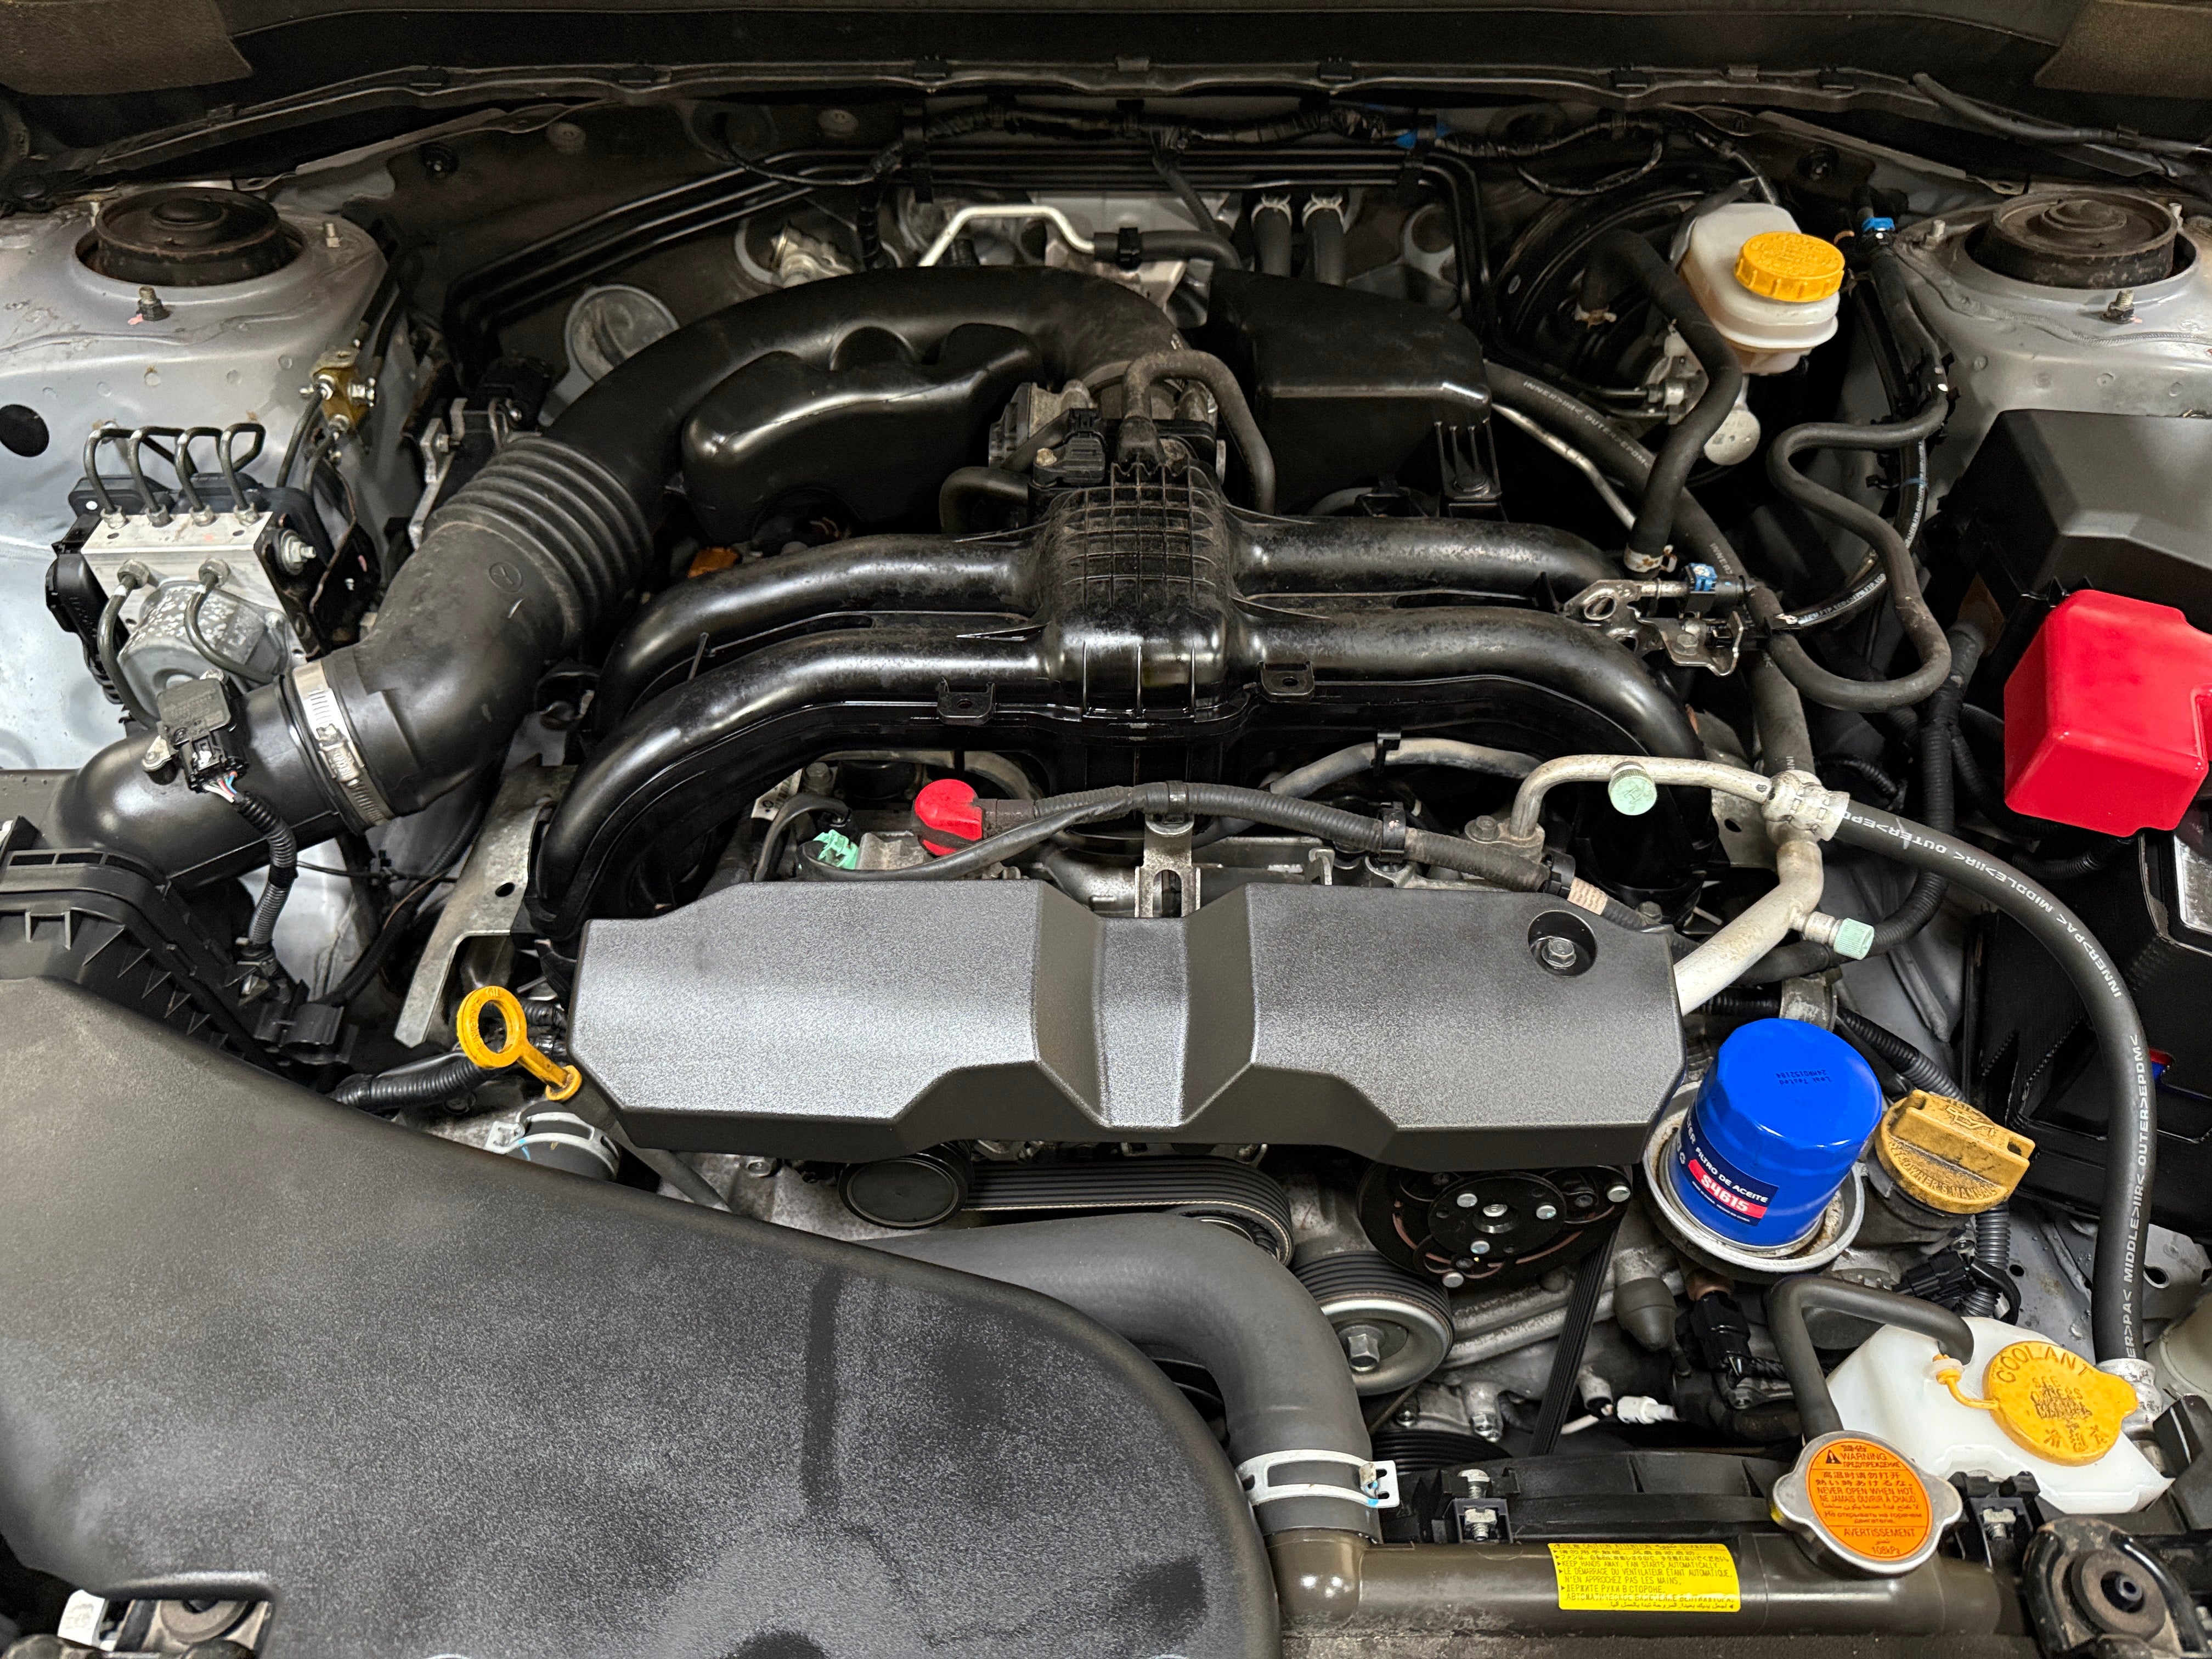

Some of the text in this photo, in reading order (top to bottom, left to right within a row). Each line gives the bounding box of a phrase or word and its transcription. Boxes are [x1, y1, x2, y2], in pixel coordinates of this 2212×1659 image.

[1953, 851, 2055, 913] MIDDLE>IIR<
[2056, 913, 2121, 998] INNER>PA<
[1695, 1147, 1718, 1175] FILTRO
[1718, 1173, 1733, 1187] DE
[1733, 1183, 1768, 1203] ACEITE
[1701, 1174, 1750, 1212] S4615
[1951, 1185, 1997, 1200] MANUAL
[2124, 1034, 2149, 1359] ER>PA< MIDDLE>IIR< OUTER>EPDM<
[1996, 1345, 2094, 1384] COOLANT
[1840, 1453, 1887, 1461] WARNING
[1844, 1528, 1915, 1537] AVERTISSEMENT
